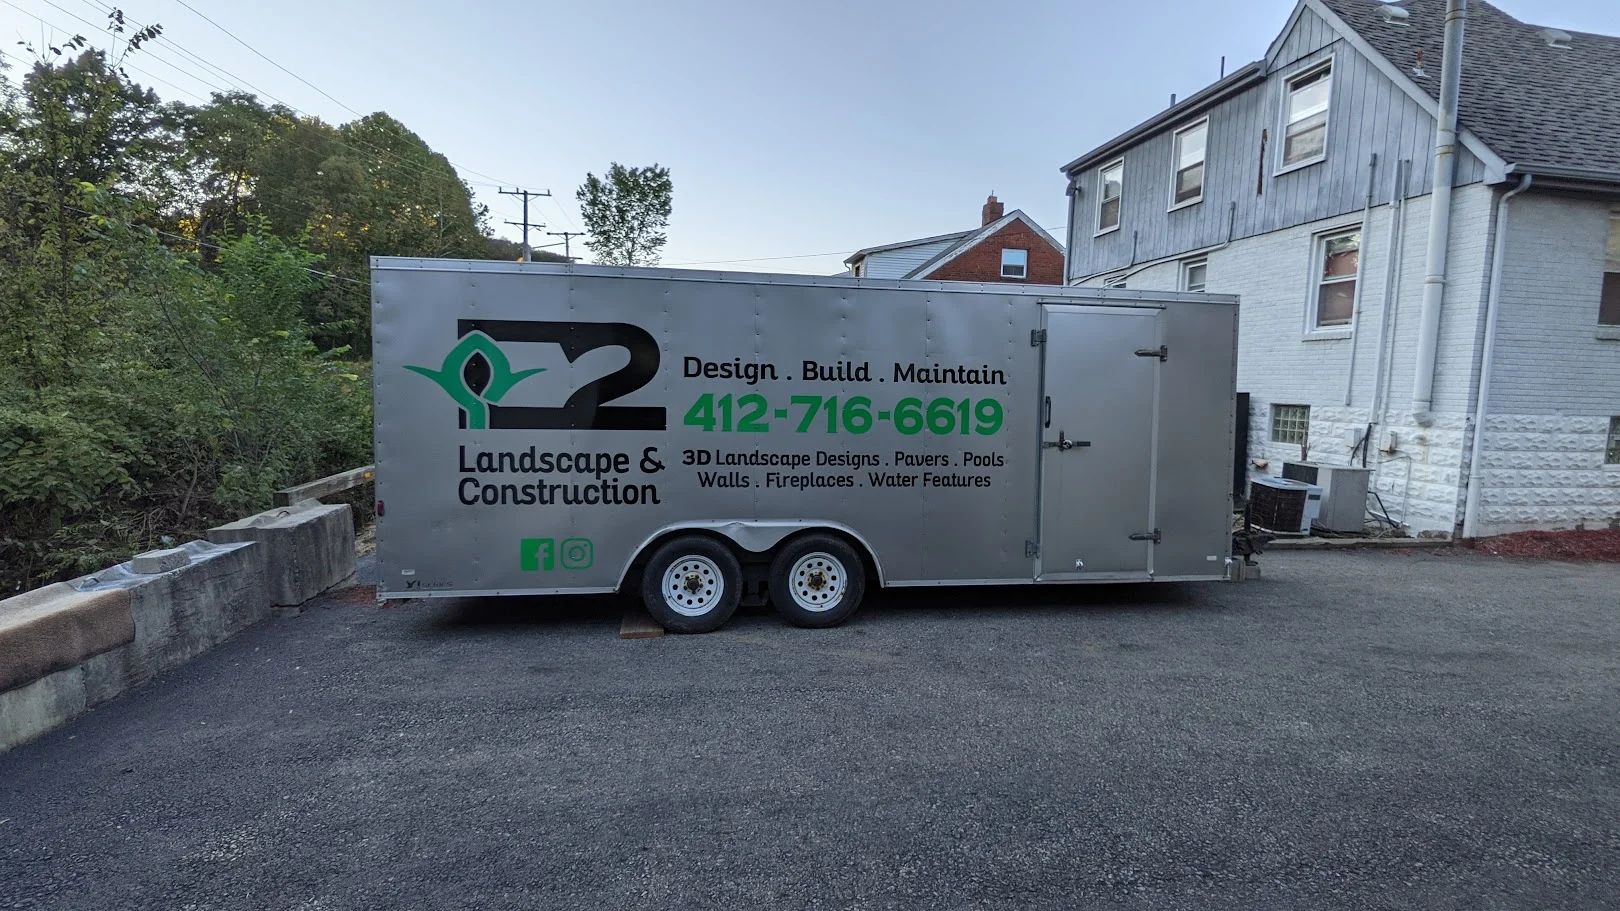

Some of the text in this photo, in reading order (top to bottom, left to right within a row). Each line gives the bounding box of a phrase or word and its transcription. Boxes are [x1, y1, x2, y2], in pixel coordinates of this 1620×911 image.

[683, 356, 779, 385] Design
[802, 360, 873, 383] Build
[893, 362, 1008, 386] Maintain
[683, 393, 1004, 436] 412-716-6619
[459, 445, 666, 480] Landscape &
[682, 449, 712, 466] 3D
[715, 450, 811, 467] Landscape
[816, 451, 880, 470] Designs
[894, 451, 950, 467] Pavers
[963, 452, 1005, 467] Pools
[458, 477, 661, 506] Construction
[697, 471, 751, 488] Walls
[766, 472, 855, 491] Fireplaces
[867, 471, 919, 488] Water
[922, 472, 991, 488] Features
